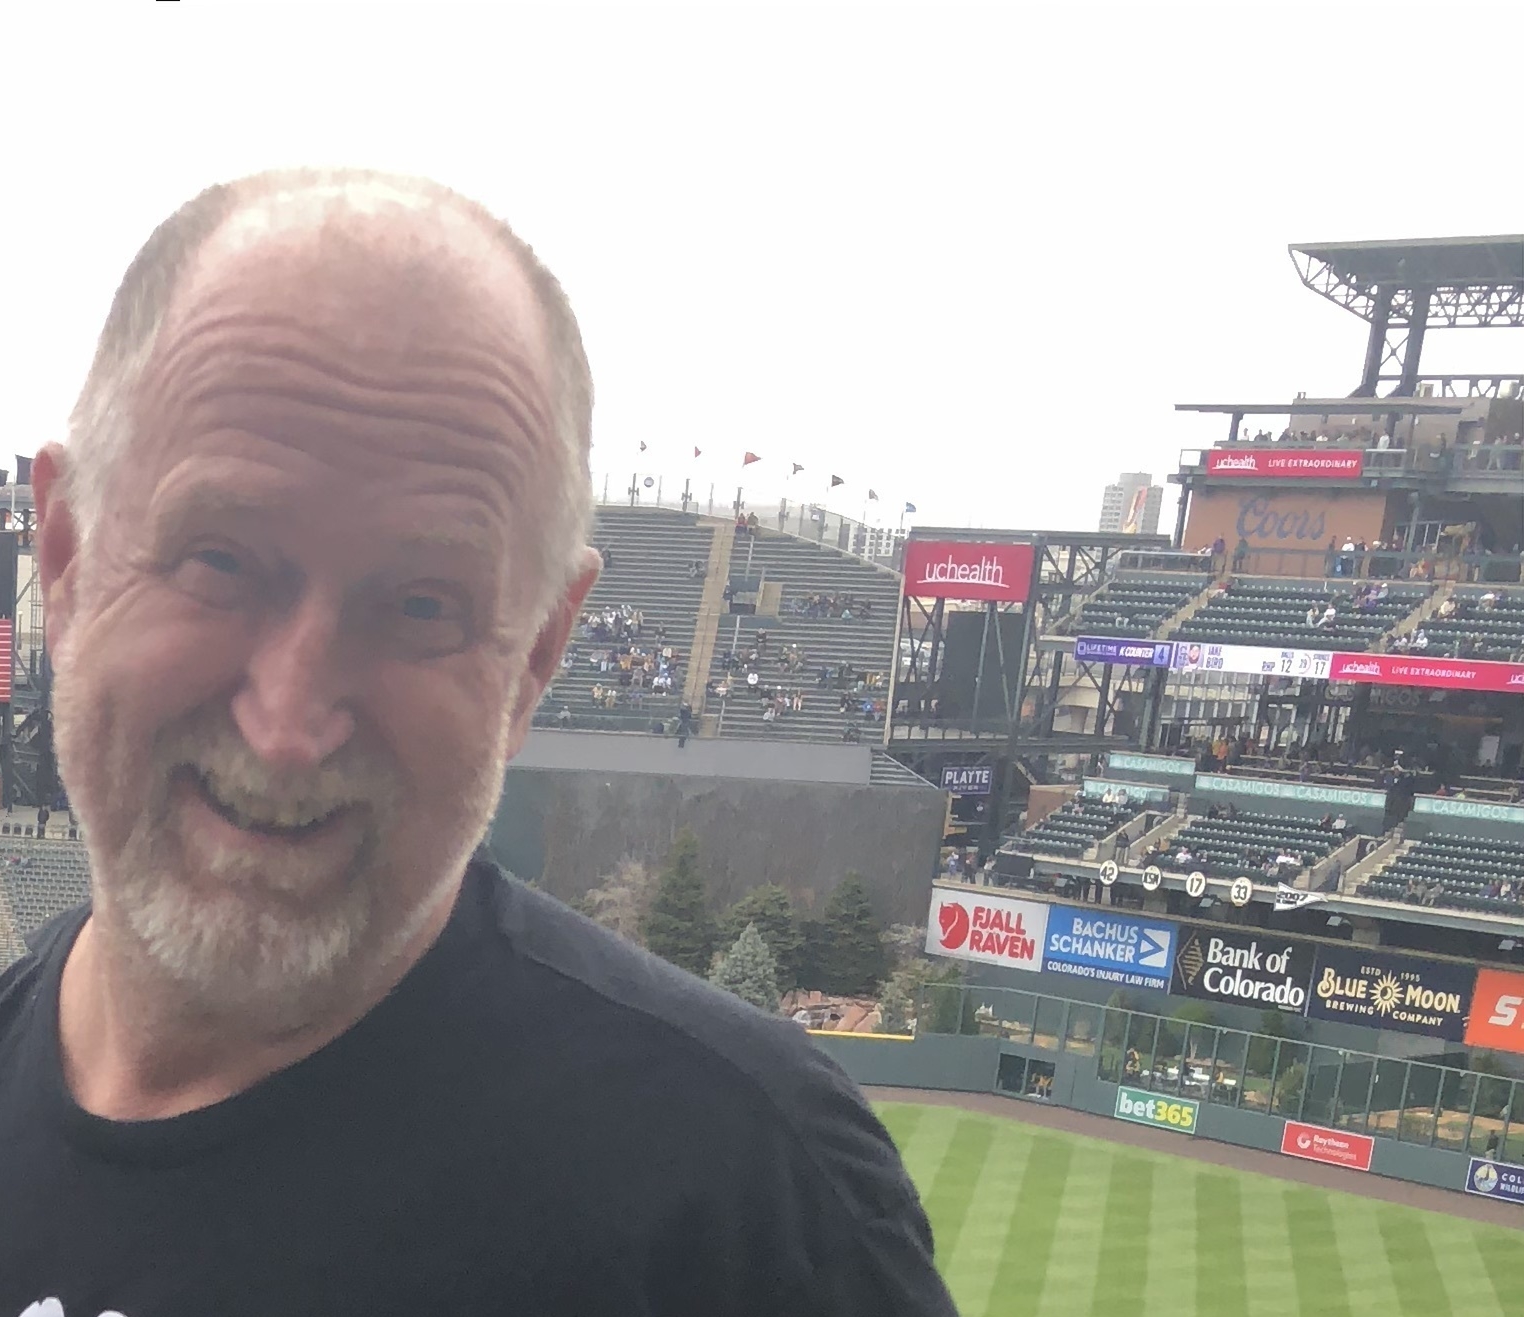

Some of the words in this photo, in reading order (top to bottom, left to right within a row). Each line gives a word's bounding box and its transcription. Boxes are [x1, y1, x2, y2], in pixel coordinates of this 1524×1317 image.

[1216, 454, 1257, 468] uchealth
[1268, 458, 1285, 468] LIVE
[1288, 458, 1358, 469] EXTRAORDINARY
[1236, 496, 1326, 541] Coors
[925, 554, 1003, 585] uchealth
[1280, 660, 1292, 674] 12
[1314, 662, 1326, 676] 17
[1342, 661, 1380, 674] uchealth
[1391, 666, 1408, 676] LIVE
[1410, 668, 1478, 680] EXTRAORDINARY
[1100, 867, 1115, 882] 42
[1190, 878, 1202, 894] 17
[1233, 884, 1248, 900] 33
[1072, 917, 1139, 944] BACHUS
[1049, 934, 1136, 964] SCHANKER
[1207, 938, 1264, 971] Bank
[1266, 946, 1293, 975] of
[1048, 960, 1096, 978] COLORADO'S
[1096, 969, 1124, 984] INJURY
[1126, 974, 1143, 985] LAW
[1144, 978, 1165, 990] FIRM
[1203, 967, 1305, 1007] Colorado
[1316, 967, 1368, 999] BLUE
[1405, 984, 1461, 1014] MOON
[1326, 999, 1374, 1016] BREWING
[1392, 1010, 1444, 1027] COMPANY
[1119, 1092, 1195, 1128] bet365
[1313, 1134, 1350, 1149] Raytheon
